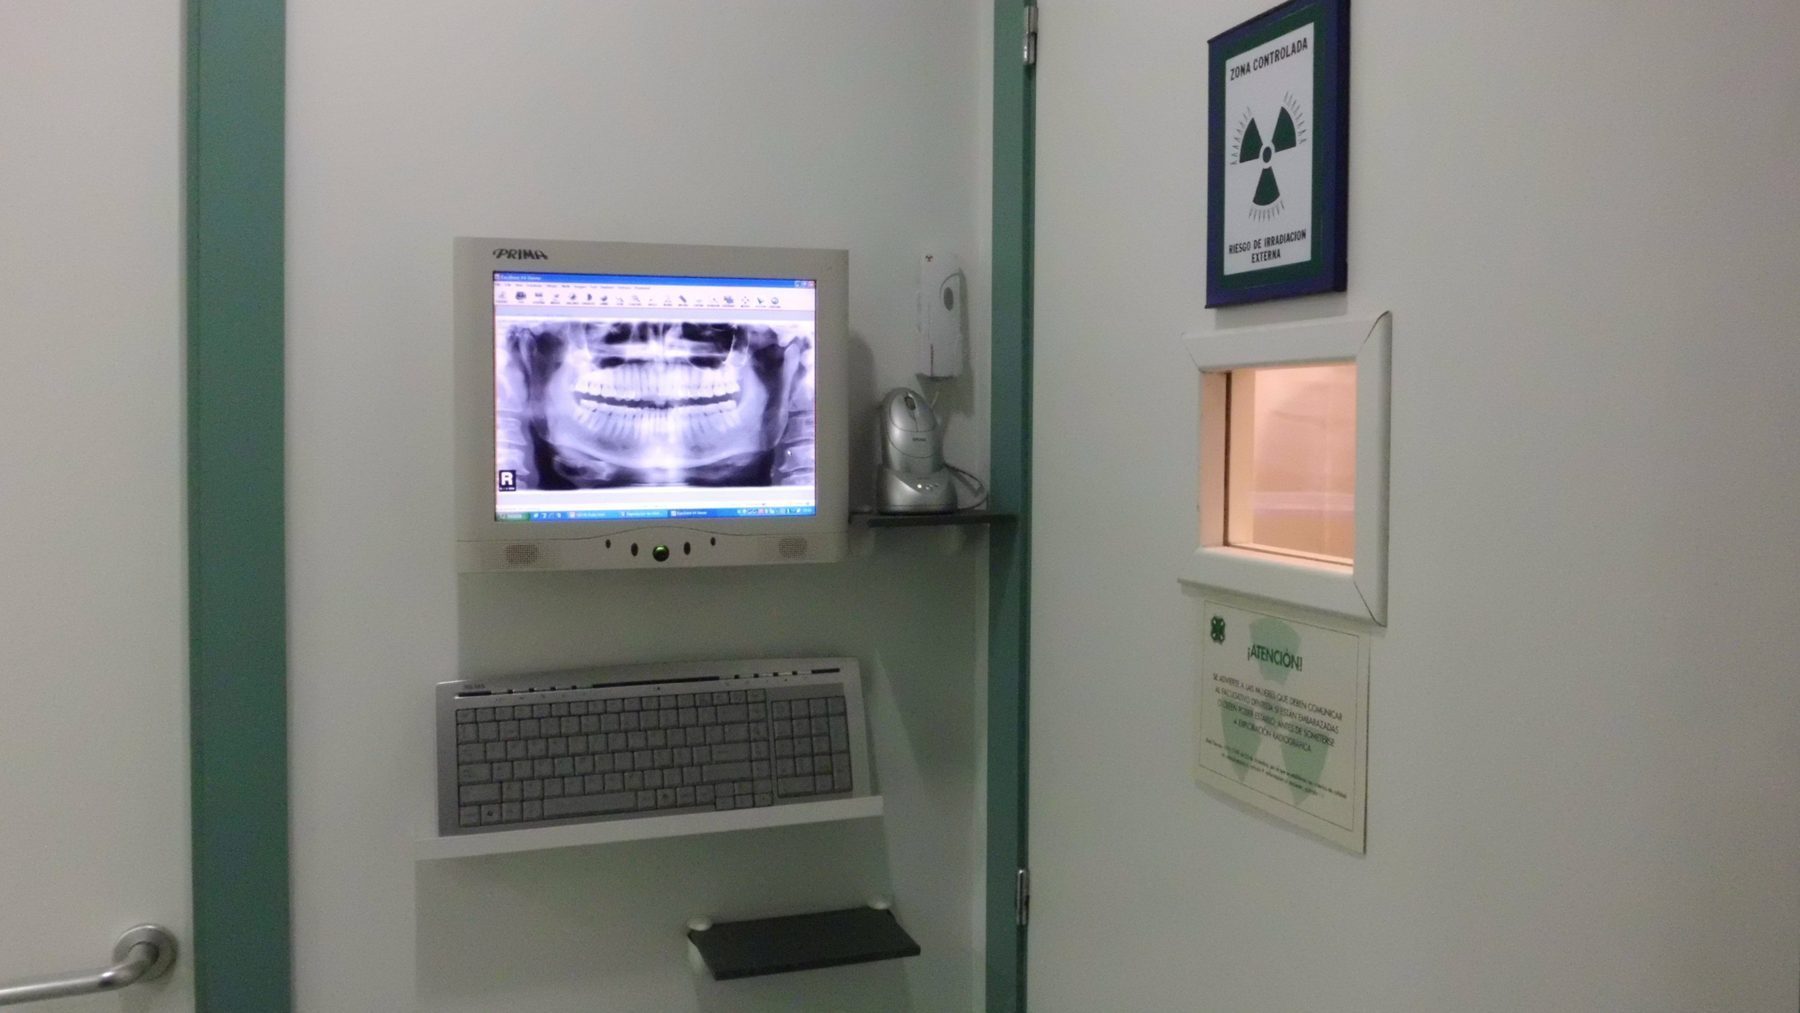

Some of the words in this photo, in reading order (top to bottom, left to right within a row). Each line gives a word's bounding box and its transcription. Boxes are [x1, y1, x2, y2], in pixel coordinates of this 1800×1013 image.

[1230, 62, 1251, 81] ZONA
[1253, 37, 1308, 71] CONTROLADA
[1229, 241, 1251, 254] RIESGO
[1253, 239, 1262, 250] DE
[492, 248, 549, 260] PRIMA
[1251, 249, 1281, 263] EXTERNA
[501, 472, 513, 486] R
